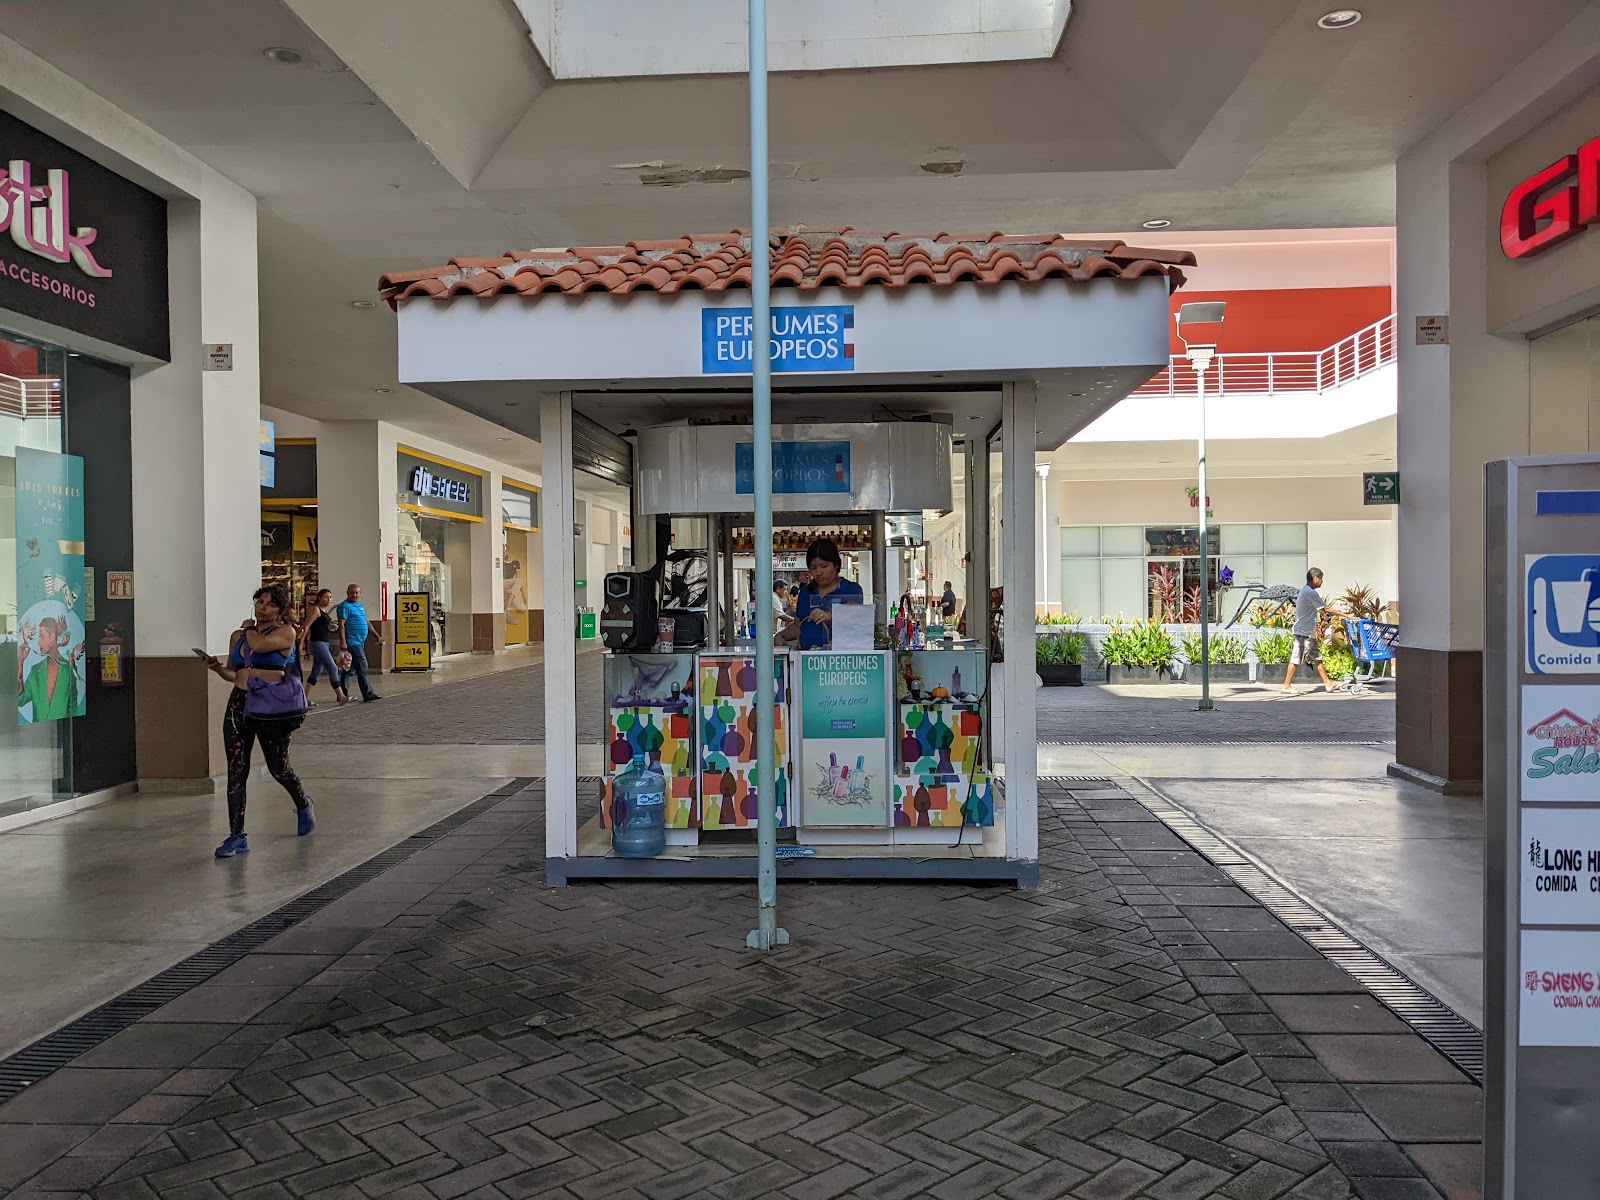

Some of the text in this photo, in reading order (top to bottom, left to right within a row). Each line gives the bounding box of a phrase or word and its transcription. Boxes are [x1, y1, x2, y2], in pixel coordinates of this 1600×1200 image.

[0, 259, 96, 308] ACCESORIOS
[716, 314, 838, 337] PERUMES
[402, 601, 420, 613] 30
[411, 647, 423, 655] 14
[807, 655, 878, 671] CON PERFUMES
[1537, 653, 1592, 666] Comida
[819, 671, 867, 686] EUROPEOS
[1535, 723, 1592, 740] Chicken
[1554, 735, 1598, 749] house
[1527, 745, 1600, 779] Sala
[1544, 848, 1582, 872] LONG
[1535, 874, 1577, 892] COMIDA
[1541, 970, 1594, 994] SHENG
[1553, 994, 1583, 1009] COMIDA
